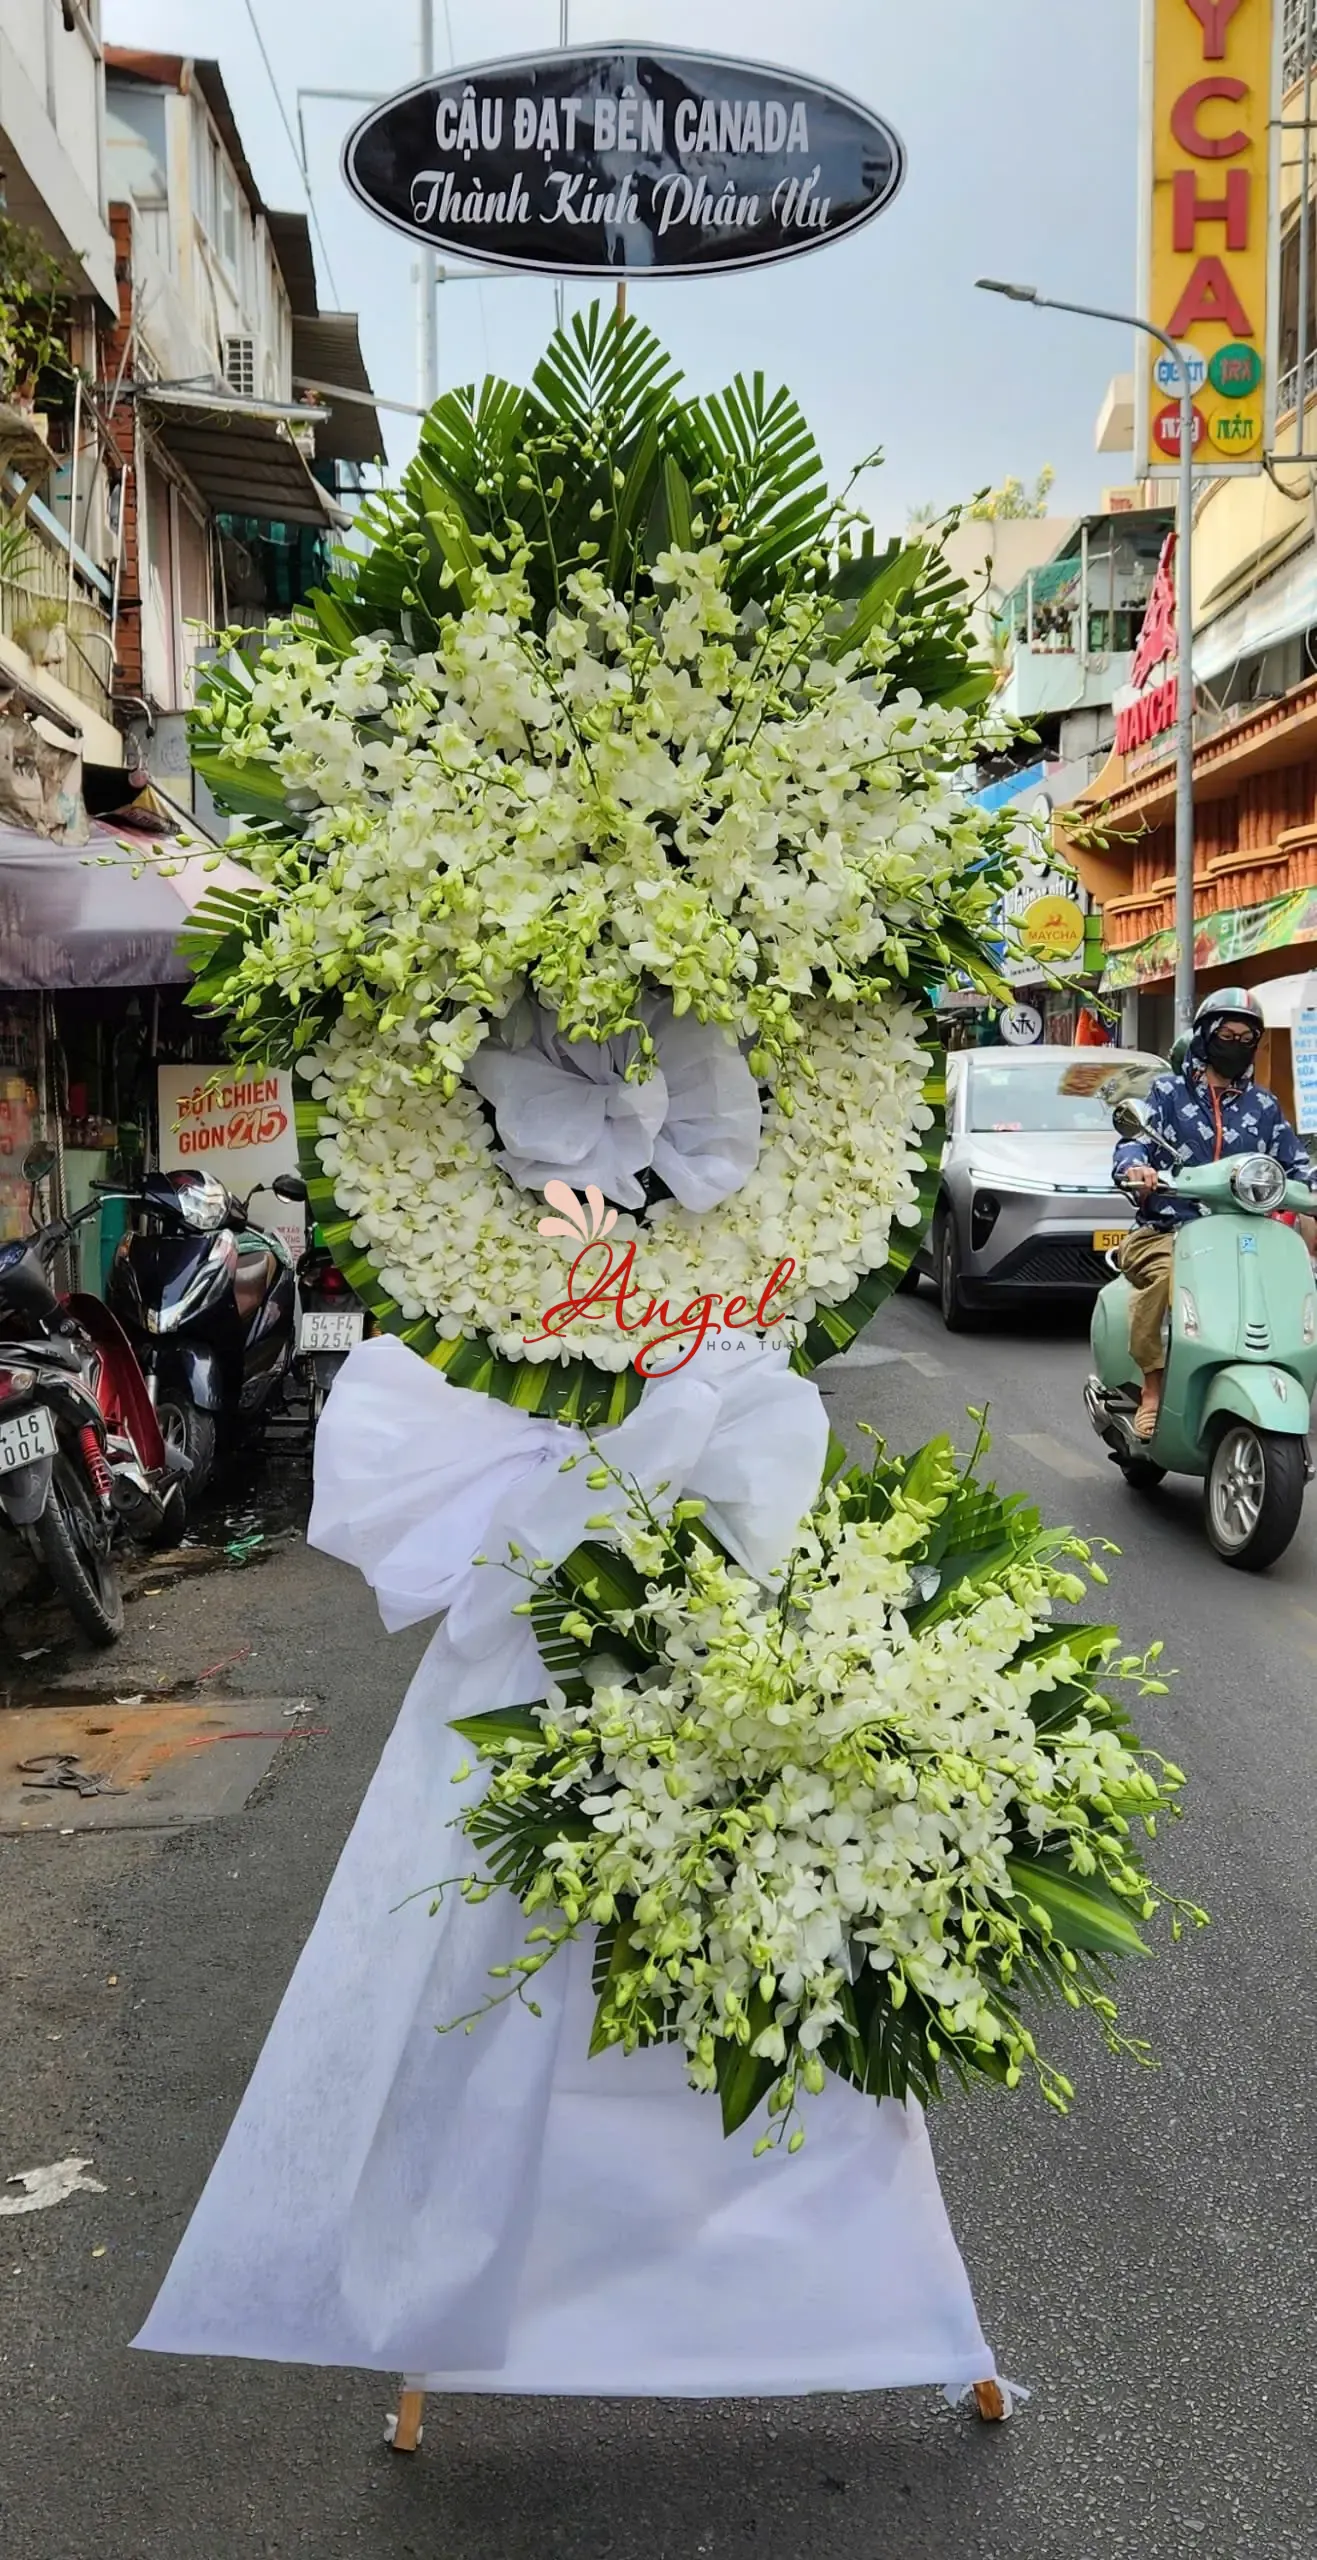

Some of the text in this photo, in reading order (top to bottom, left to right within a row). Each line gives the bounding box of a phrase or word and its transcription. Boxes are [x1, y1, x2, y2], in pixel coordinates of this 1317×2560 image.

[435, 85, 809, 162] CẬU ĐẠT BÊN CANADA
[410, 170, 532, 224] Thành
[539, 170, 640, 225] Kính
[652, 173, 762, 236] Phân
[1116, 675, 1178, 756] MAYCH
[1028, 930, 1078, 941] MAYCHA
[227, 1104, 288, 1150] 215
[310, 1332, 352, 1348] 9254
[311, 1315, 353, 1331] 54-F4
